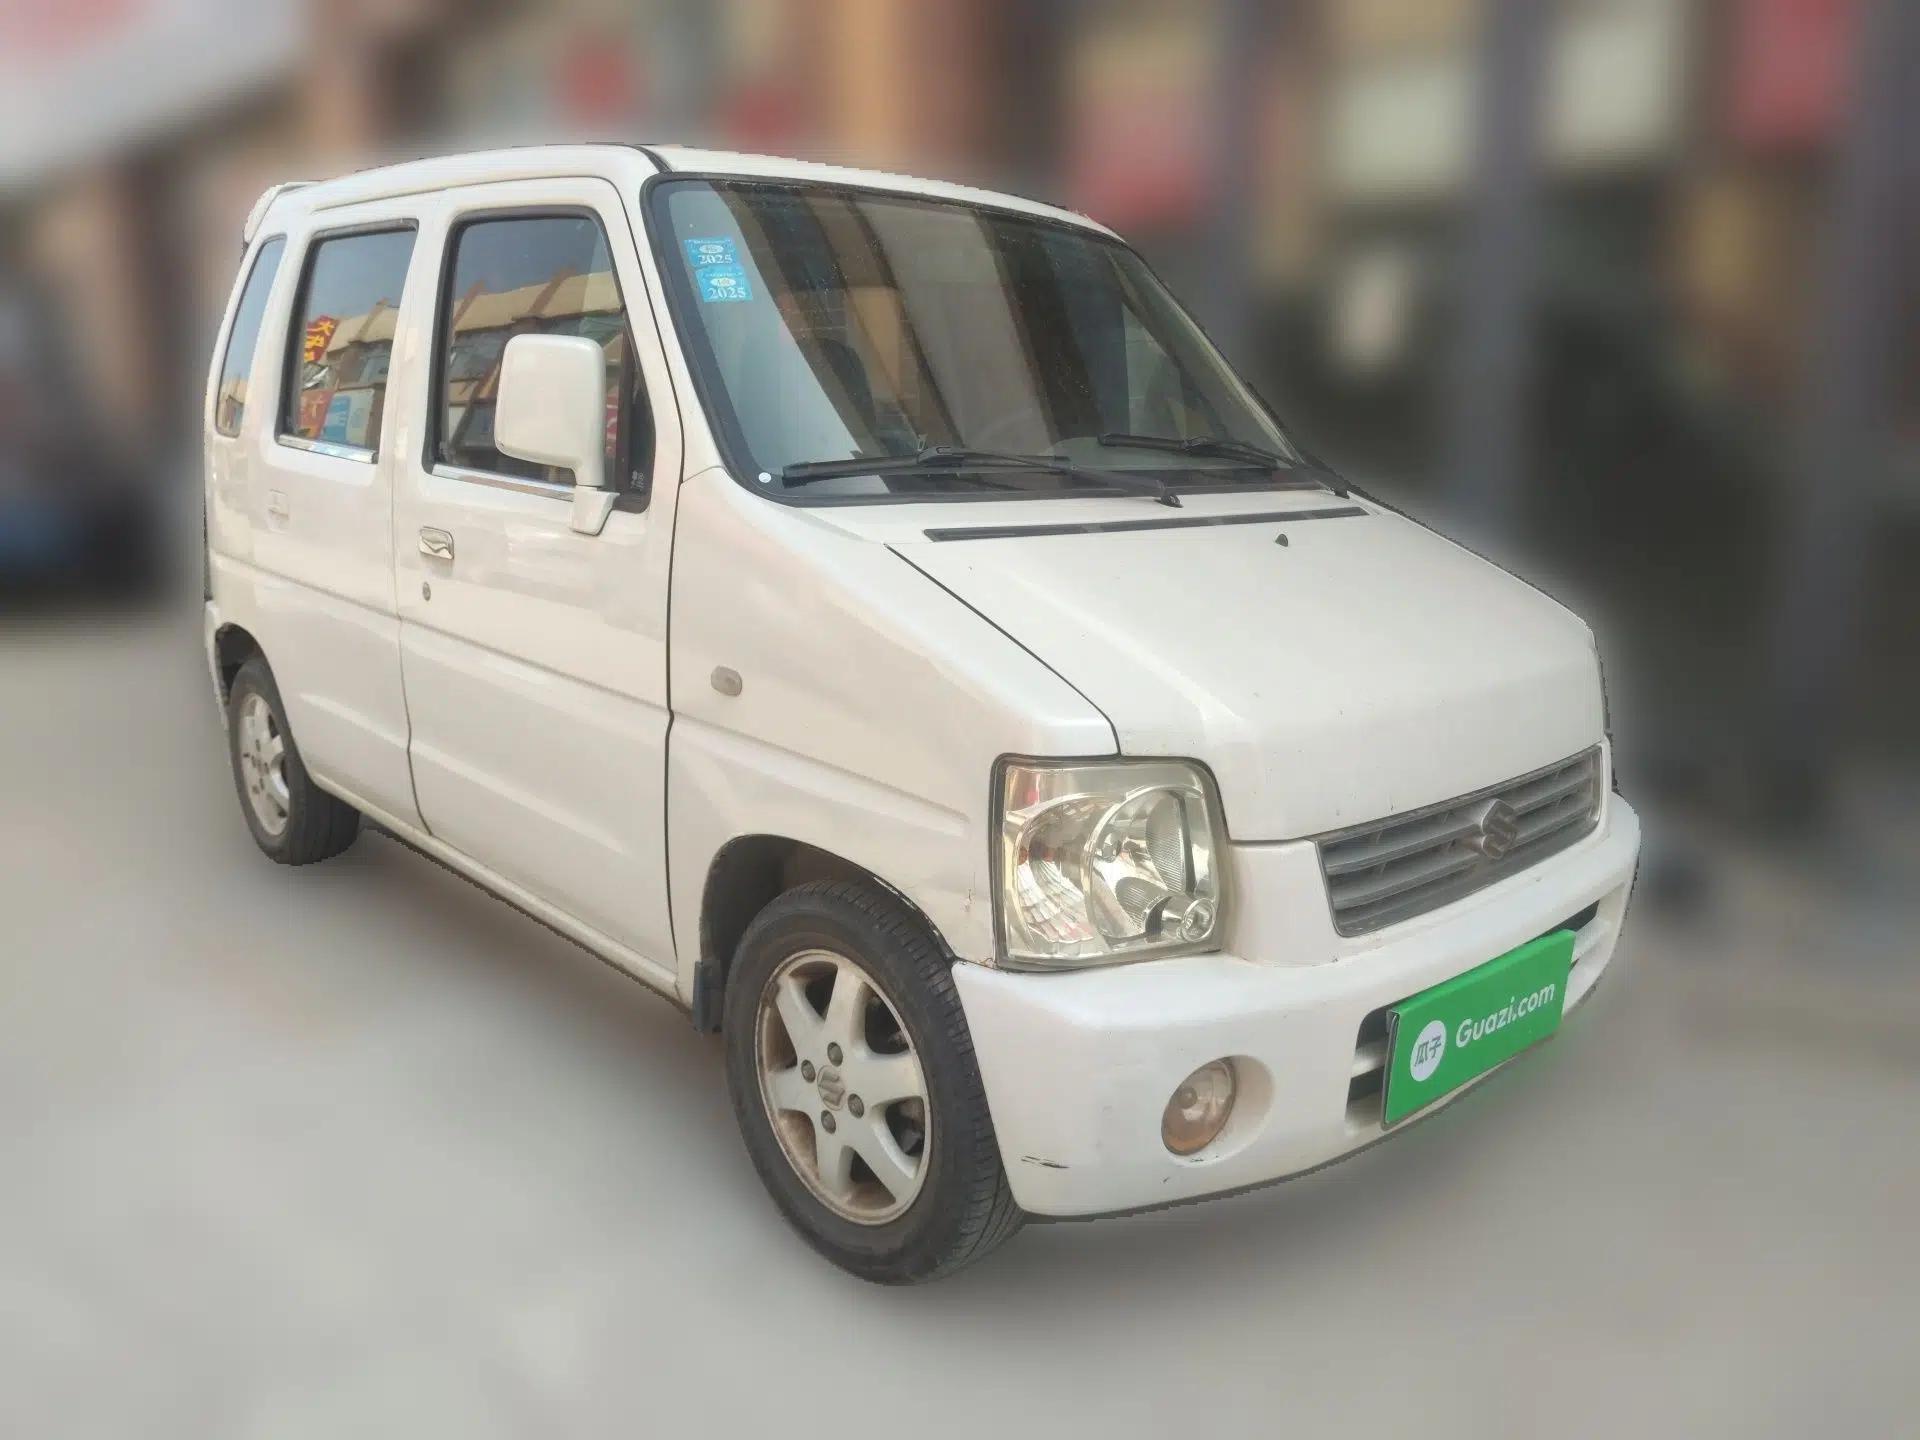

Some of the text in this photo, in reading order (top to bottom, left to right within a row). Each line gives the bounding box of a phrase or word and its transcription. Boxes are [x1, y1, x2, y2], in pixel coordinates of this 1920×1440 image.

[698, 254, 733, 264] 2025
[707, 286, 746, 299] 2025
[1455, 983, 1555, 1048] Guazi.com
[1414, 1033, 1442, 1067] 瓜子
